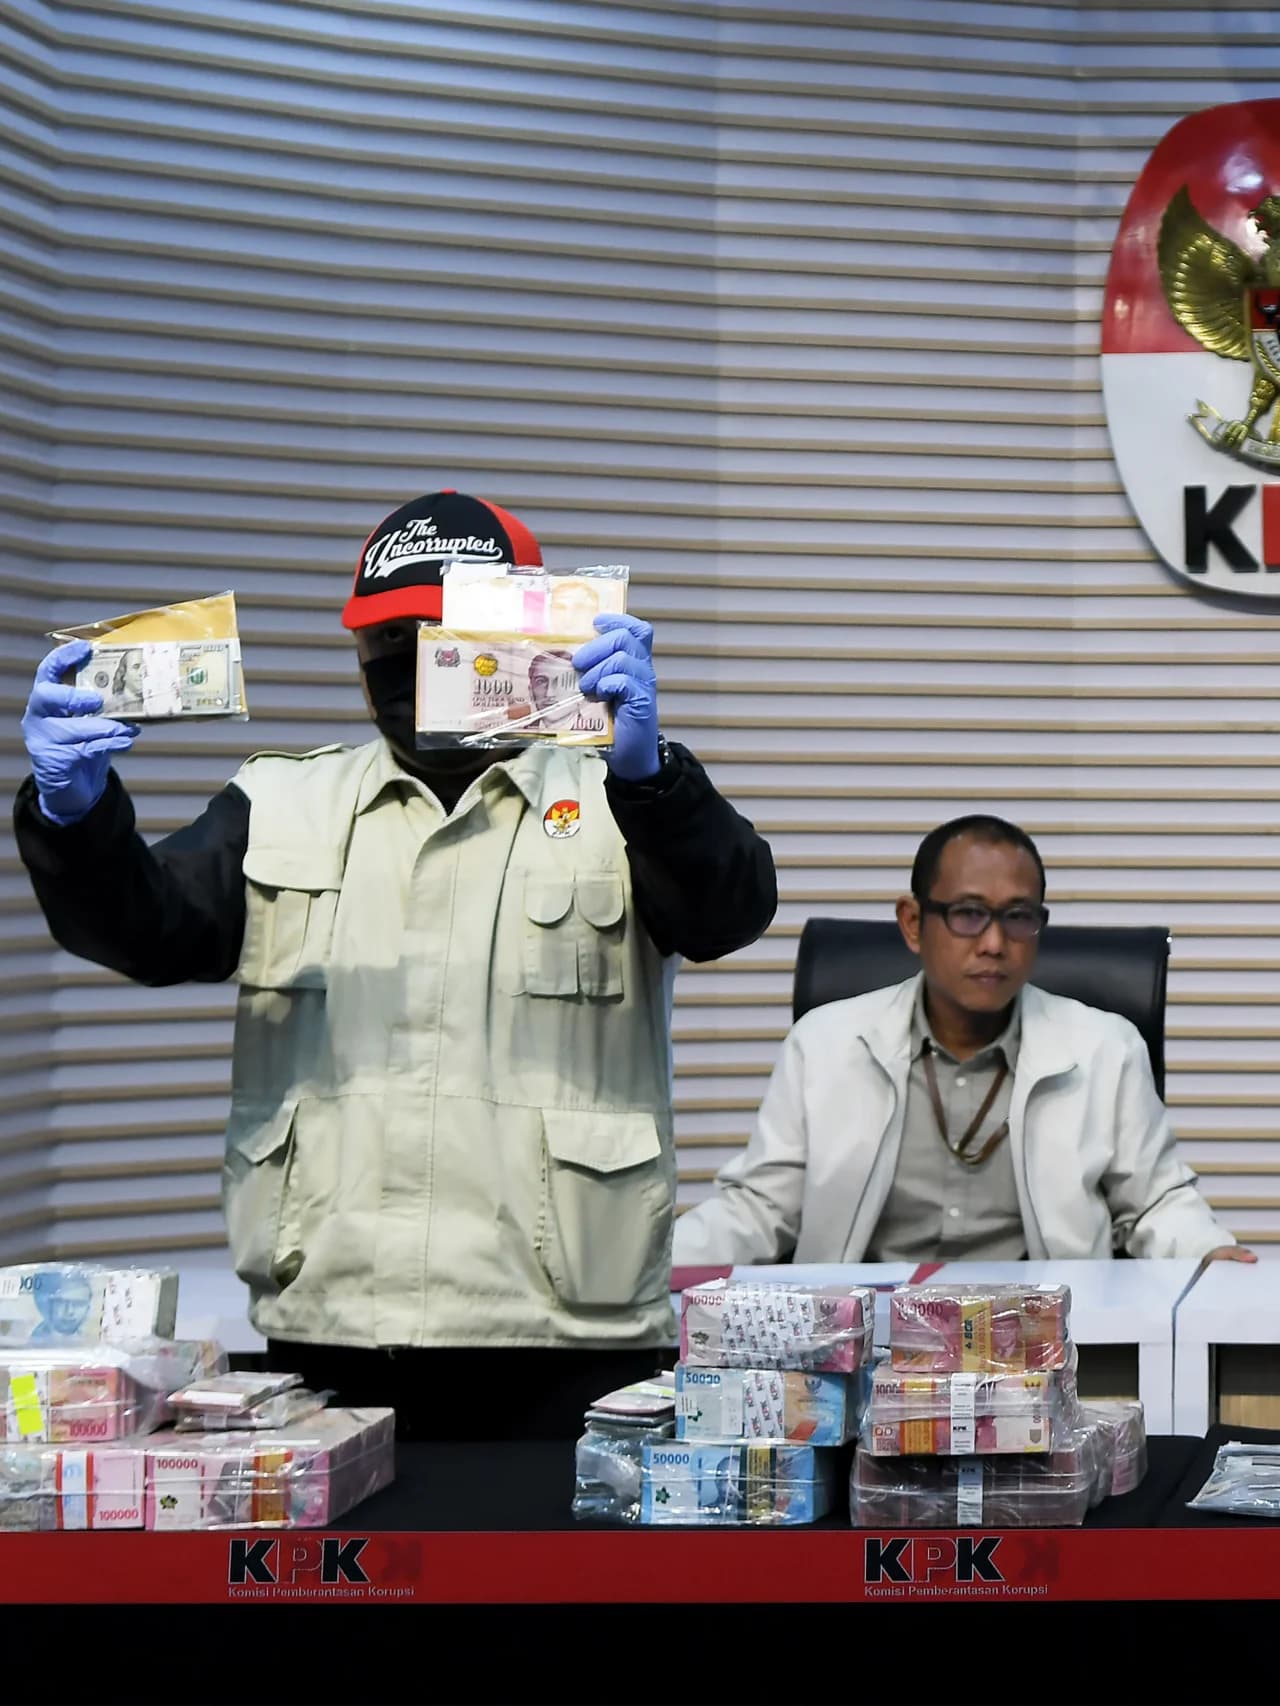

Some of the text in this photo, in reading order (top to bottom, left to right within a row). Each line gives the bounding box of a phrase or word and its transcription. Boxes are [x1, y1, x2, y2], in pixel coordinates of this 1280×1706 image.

[400, 516, 437, 543] The
[364, 530, 503, 579] Uncorrupted
[473, 679, 514, 695] 1000
[686, 1372, 721, 1385] 50000
[69, 1422, 108, 1436] 100000
[157, 1458, 198, 1470] 100000
[653, 1453, 690, 1465] 50000
[100, 1510, 139, 1521] 100000
[228, 1538, 371, 1584] KPK
[864, 1536, 1006, 1584] KPK
[228, 1585, 415, 1597] Komisi Pemberantasan Korupsi
[864, 1584, 1048, 1597] Komisi Pemberantasan Korupsi
